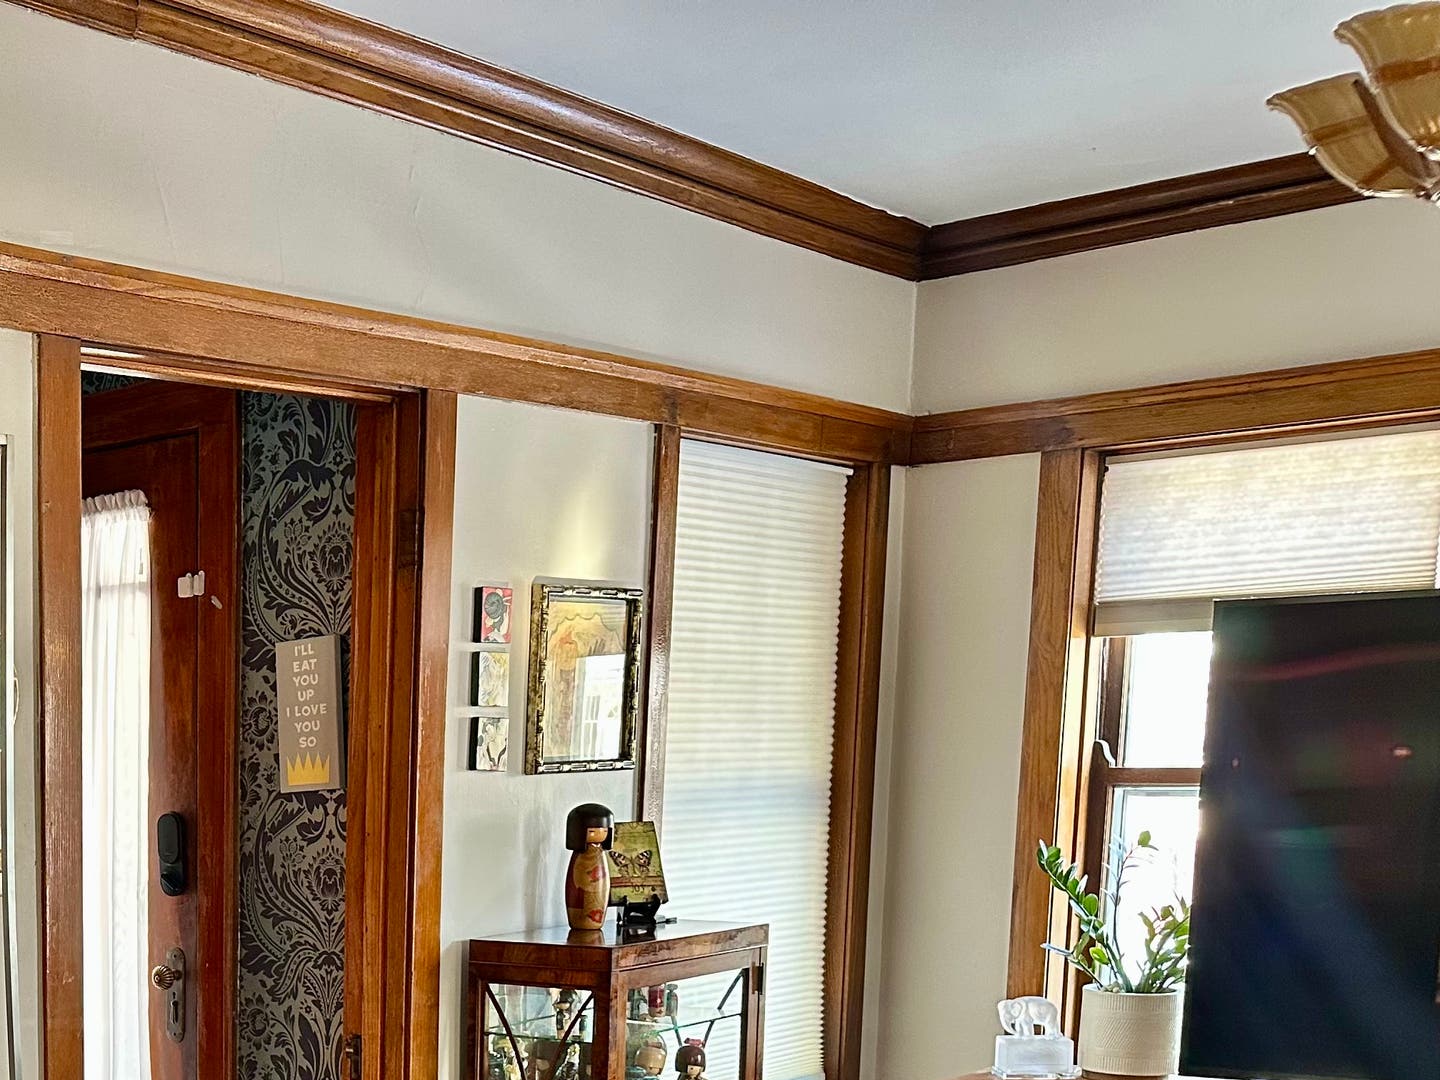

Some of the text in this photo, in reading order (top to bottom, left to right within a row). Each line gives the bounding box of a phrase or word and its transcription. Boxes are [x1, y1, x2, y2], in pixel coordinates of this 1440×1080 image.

[294, 643, 315, 657] I'LL
[292, 658, 318, 673] EAT
[292, 673, 319, 687] YOU
[297, 689, 315, 702] UP
[286, 703, 328, 718] I LOVE
[294, 720, 321, 734] YOU
[298, 736, 317, 748] SO
